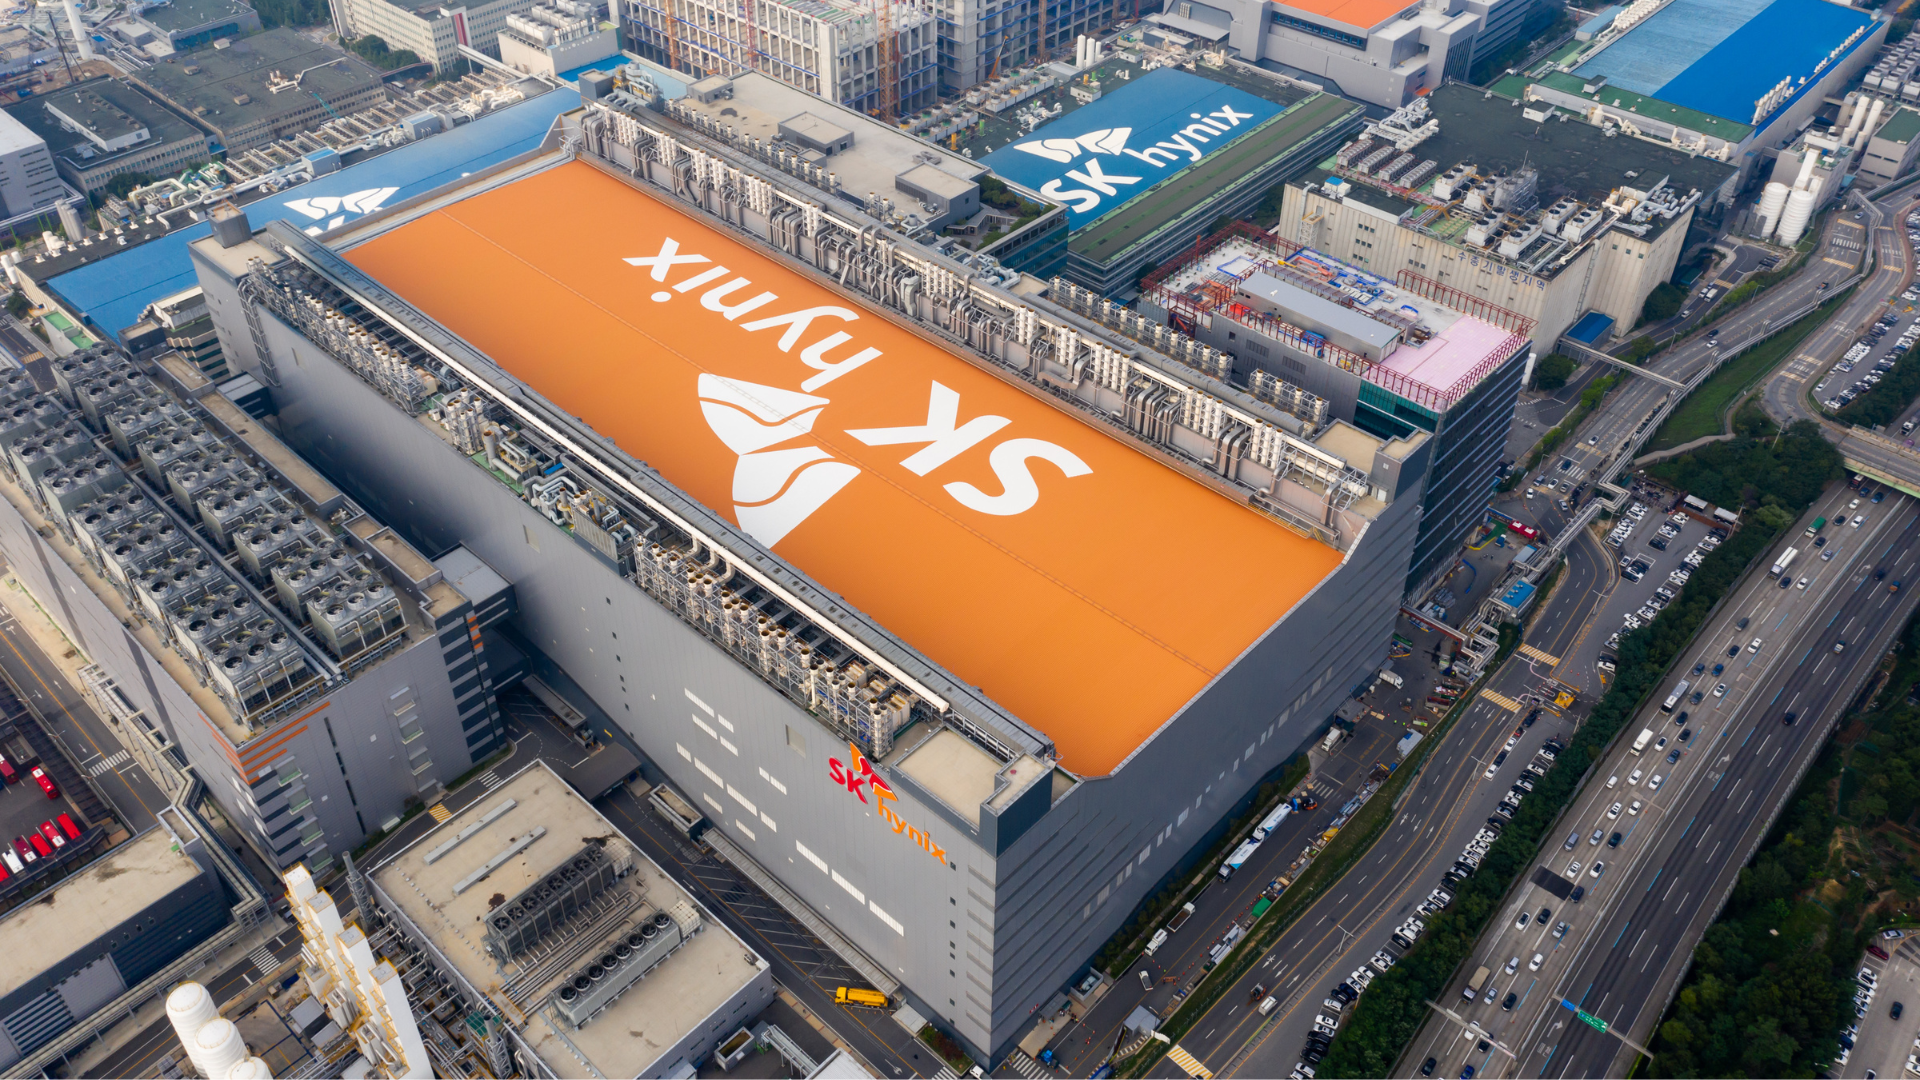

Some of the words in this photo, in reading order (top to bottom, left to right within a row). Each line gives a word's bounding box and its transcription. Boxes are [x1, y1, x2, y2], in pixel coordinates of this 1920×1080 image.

[1040, 158, 1143, 213] SK
[1122, 105, 1254, 168] hynix
[623, 237, 883, 392] hynix
[1458, 252, 1545, 291] 수증기발생지역
[844, 380, 1093, 516] SK
[828, 757, 868, 805] SK
[877, 796, 948, 865] hynix
